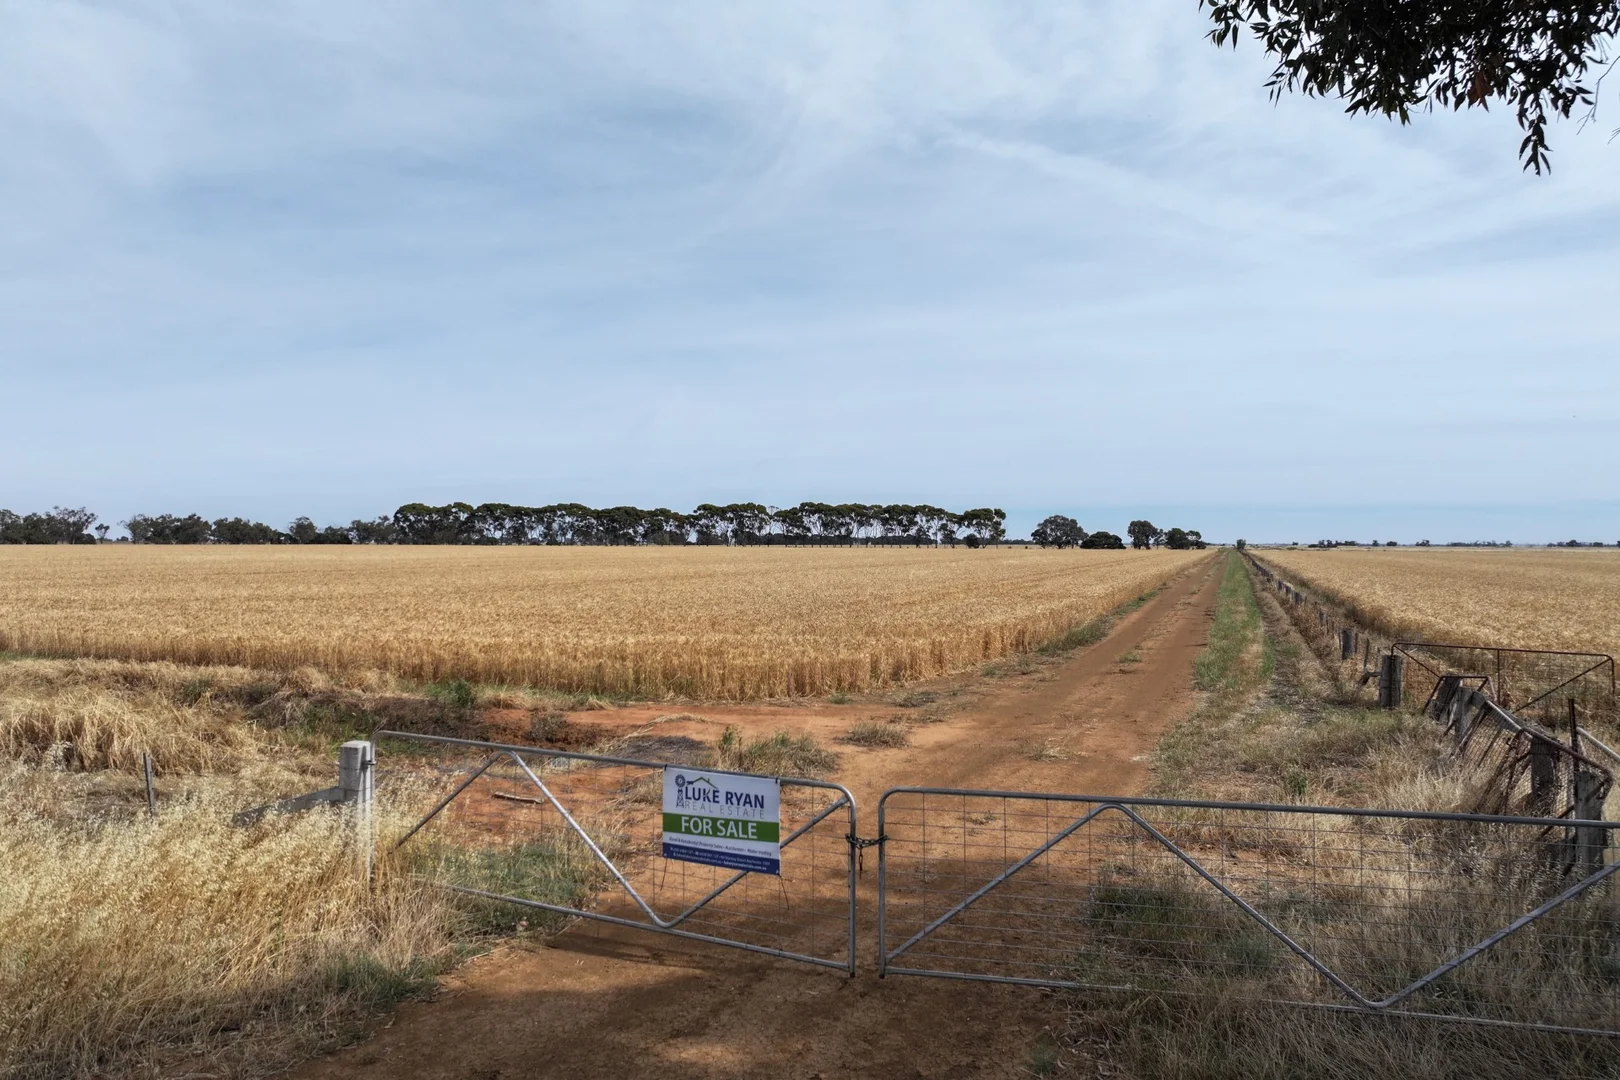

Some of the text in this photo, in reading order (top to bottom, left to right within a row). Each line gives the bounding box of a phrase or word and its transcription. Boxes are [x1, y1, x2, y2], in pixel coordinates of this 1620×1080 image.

[685, 786, 764, 809] LUKE RYAN
[685, 801, 764, 819] REAL ESTATE
[681, 816, 757, 839] FOR SALE
